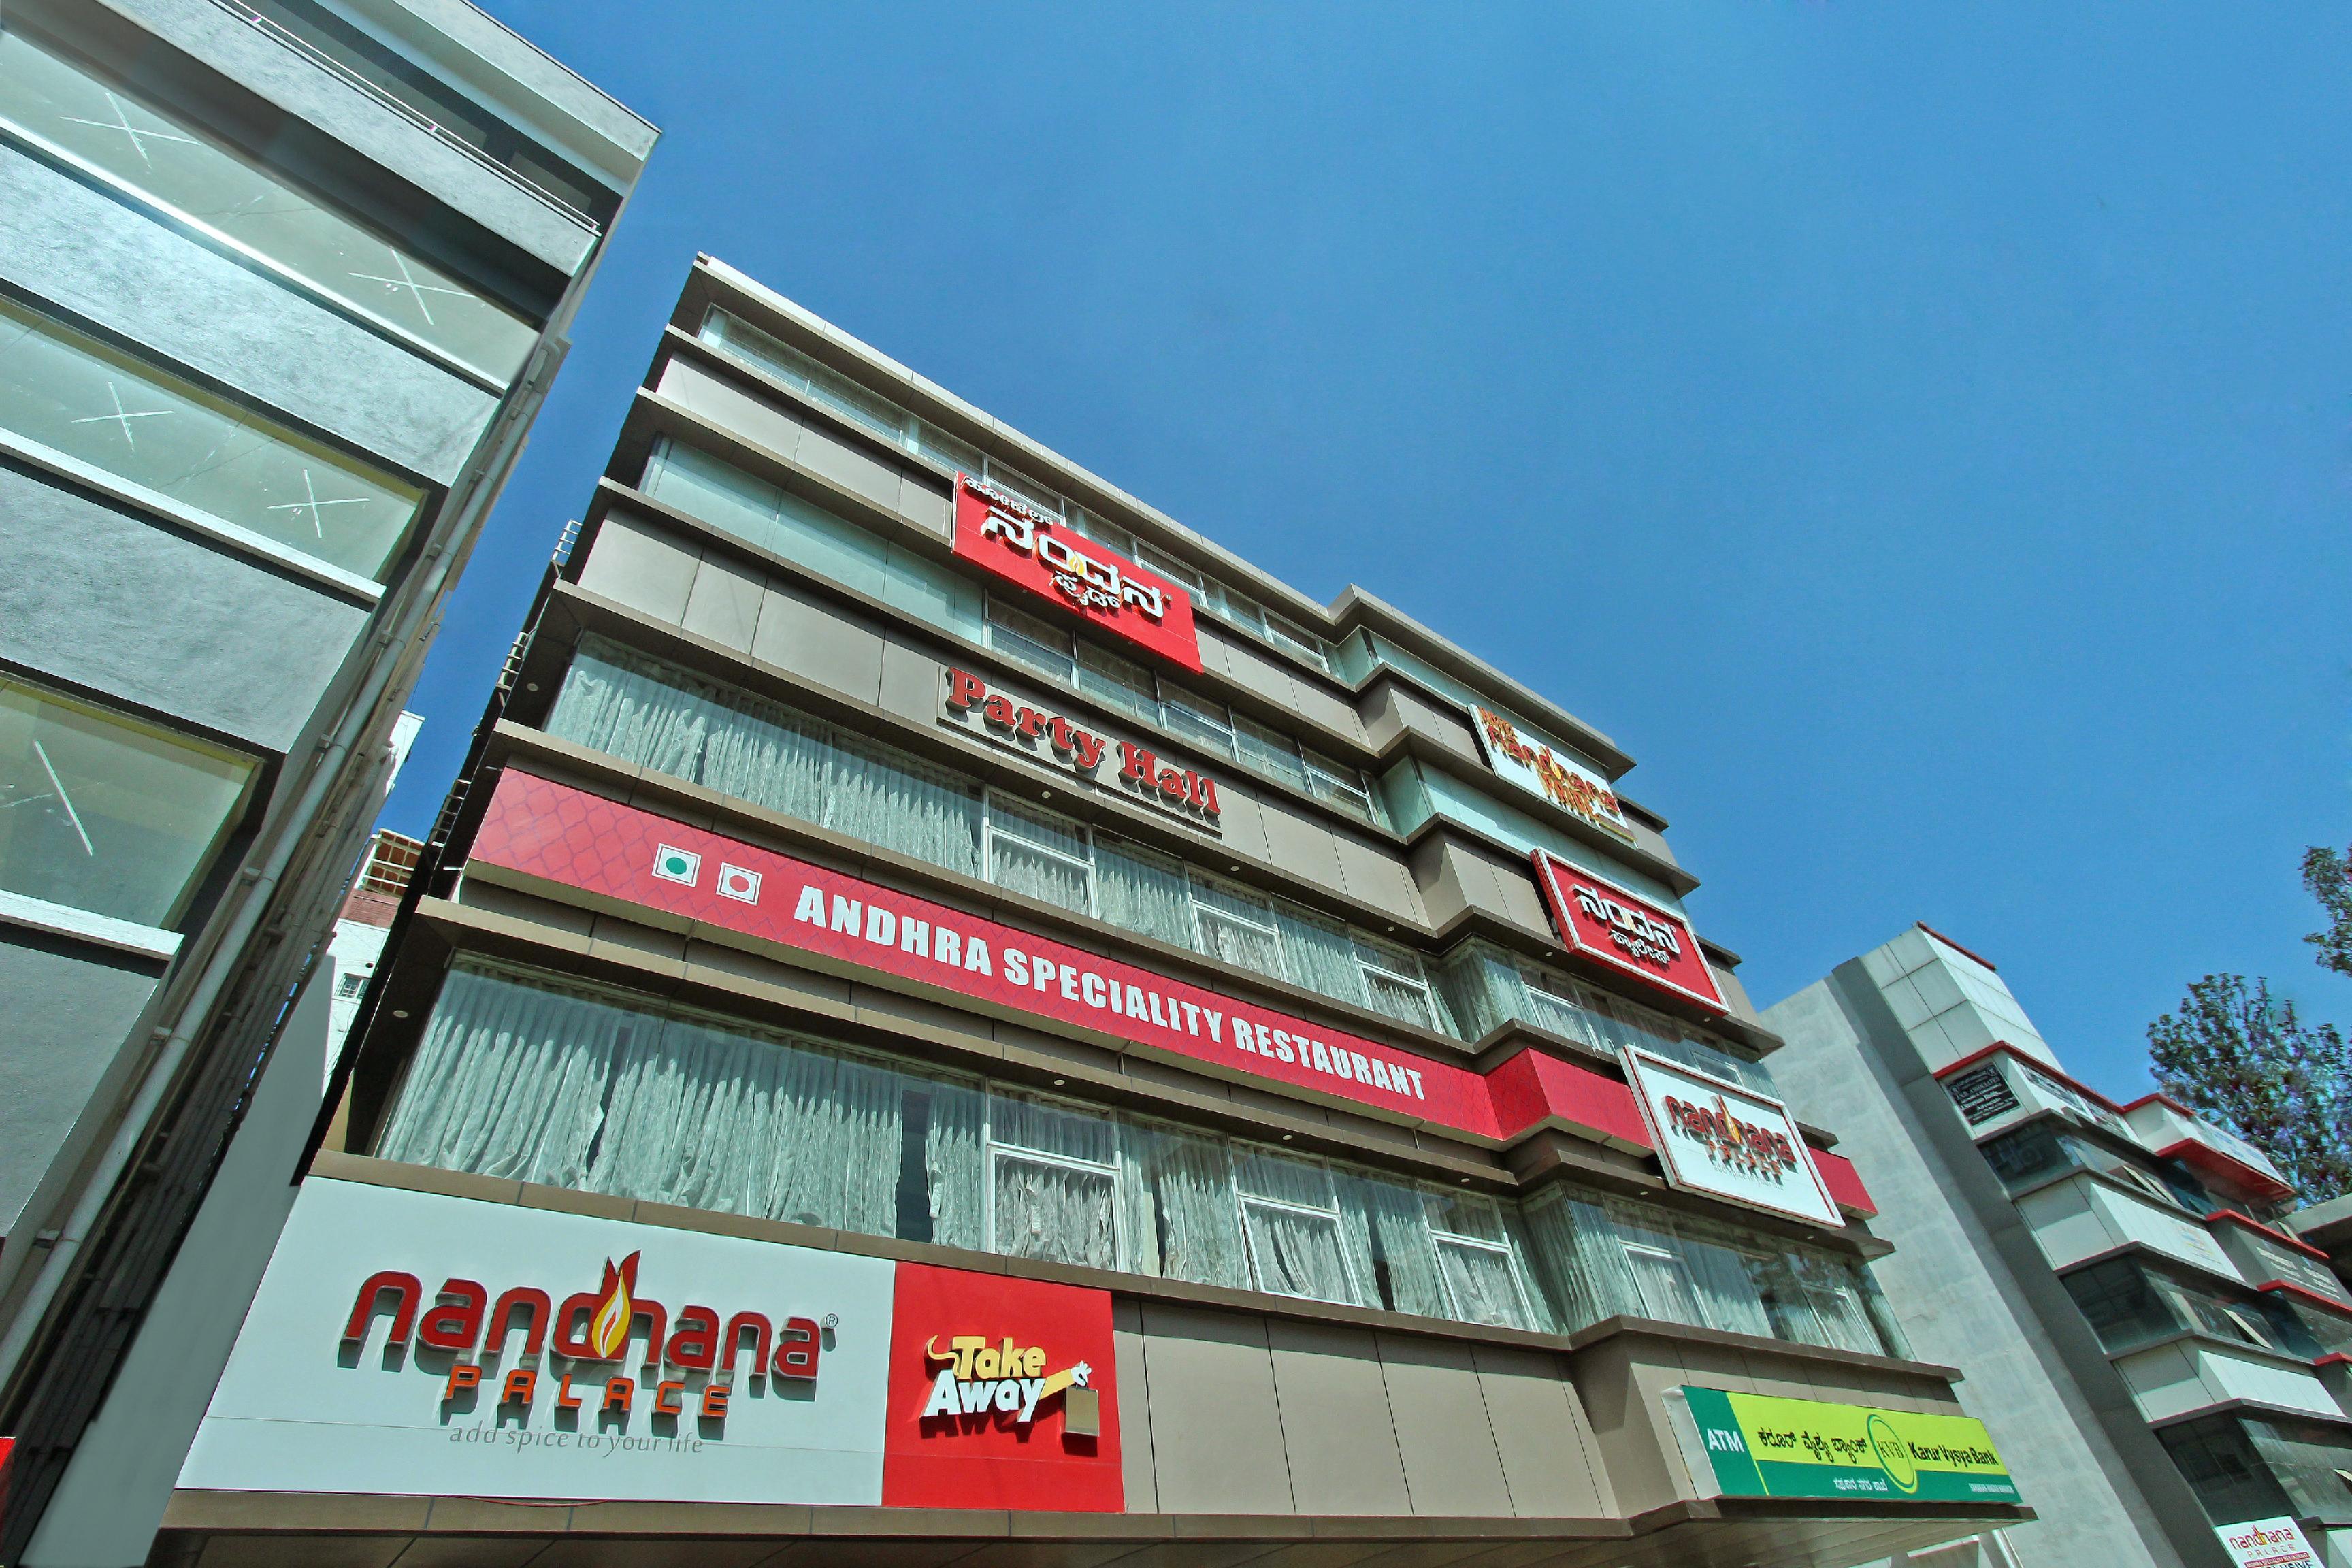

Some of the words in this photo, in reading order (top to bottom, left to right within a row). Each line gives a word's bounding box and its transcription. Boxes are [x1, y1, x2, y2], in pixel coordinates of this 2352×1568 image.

[981, 506, 1164, 618] ನಂದನ
[947, 666, 1107, 769] Party
[1117, 740, 1223, 817] Hall
[1571, 883, 1682, 954] ನಂದನ
[793, 885, 992, 977] ANDHRA
[1003, 948, 1223, 1044] SPECIALITY
[1230, 1015, 1425, 1100] RESTAURANT
[1663, 1094, 1797, 1164] nandhana
[344, 1250, 821, 1380] nandhana
[927, 1335, 1047, 1379] Take
[444, 1365, 732, 1418] PALACE
[919, 1369, 1047, 1423] Away
[449, 1420, 497, 1444] add
[505, 1426, 569, 1454] spice
[577, 1431, 600, 1449] to
[603, 1435, 662, 1458] your
[668, 1431, 704, 1453] life
[1707, 1428, 1744, 1452] ATM
[1757, 1426, 1797, 1448] ಕರೂರ್
[1831, 1437, 1867, 1463] ಬ್ಯಾಂಕ್
[1876, 1441, 1904, 1459] KVB
[1907, 1441, 1941, 1461] Karur
[1938, 1444, 1972, 1467] Vysya
[1968, 1446, 1999, 1466] Bank
[2229, 1524, 2295, 1550] nandhana
[2247, 1543, 2297, 1558] PALACE
